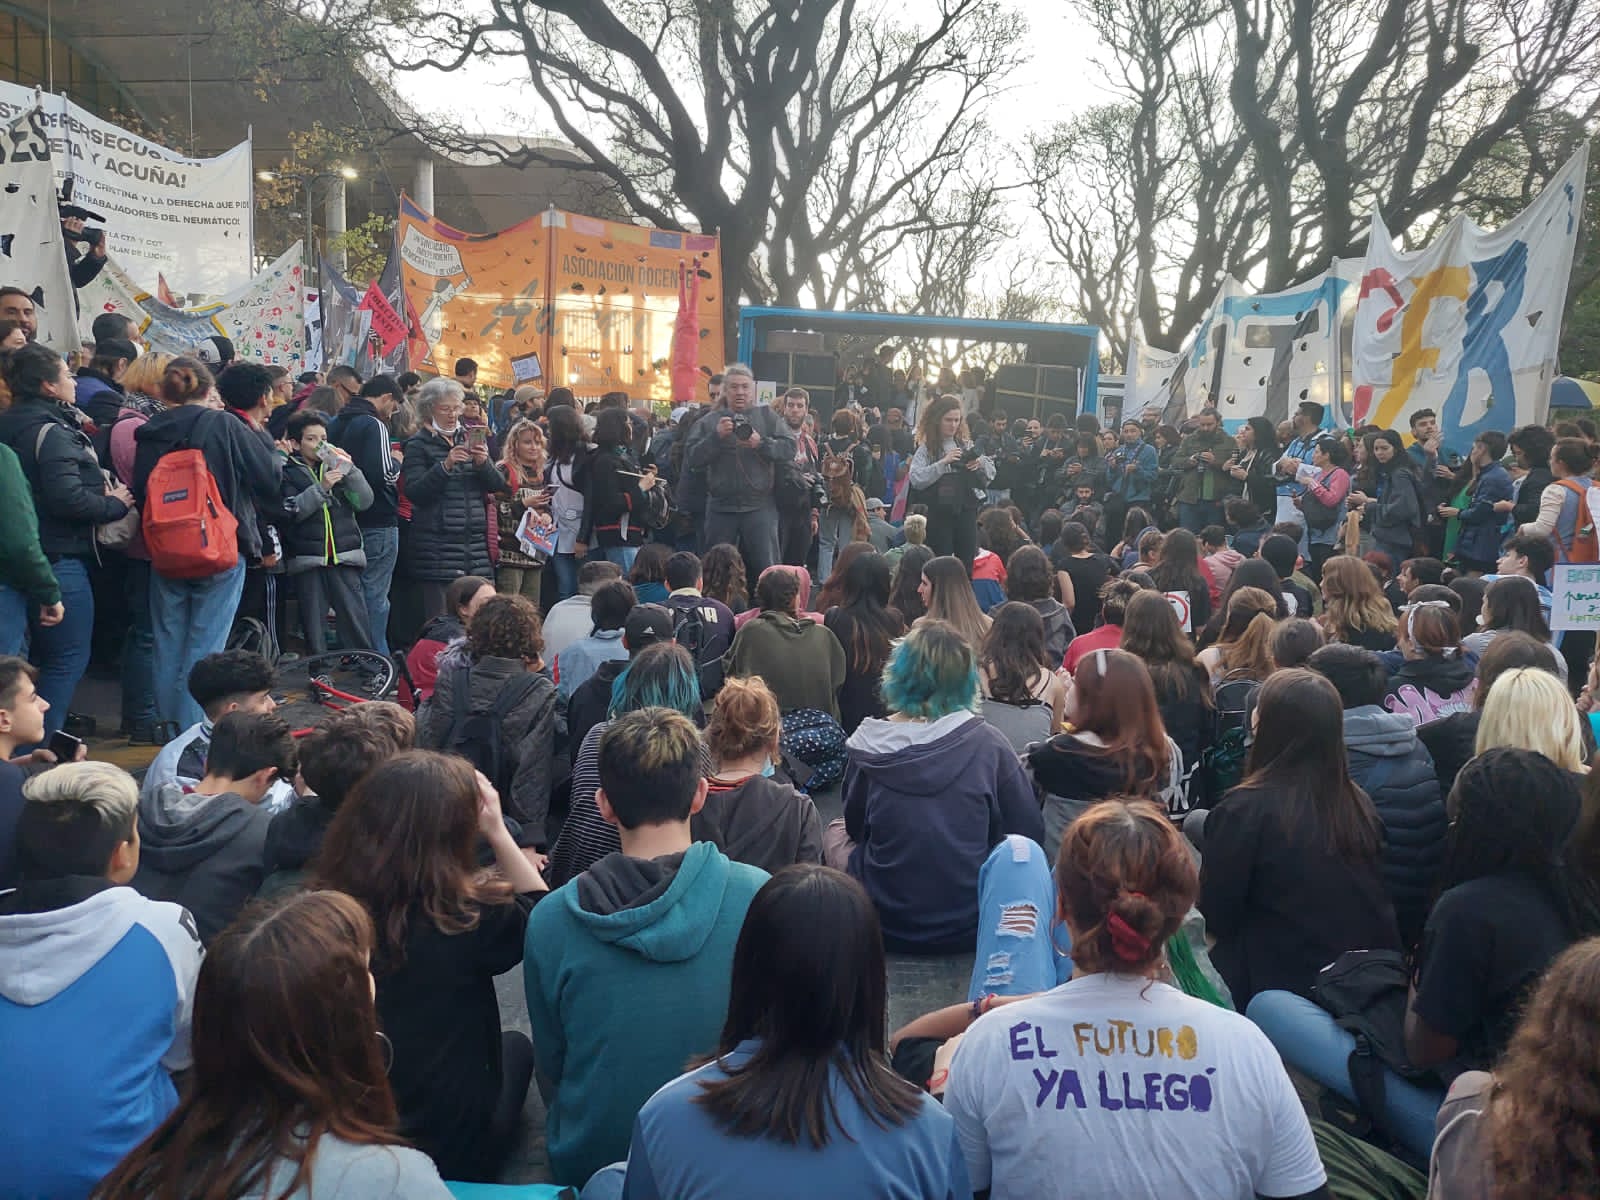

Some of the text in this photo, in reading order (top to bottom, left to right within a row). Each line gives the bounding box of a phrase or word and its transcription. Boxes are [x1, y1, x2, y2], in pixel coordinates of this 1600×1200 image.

[91, 152, 101, 166] Y
[104, 157, 187, 190] ACUÑA!
[150, 196, 165, 206] LA
[166, 198, 214, 209] DERECHA
[215, 201, 233, 210] QUE
[160, 213, 181, 223] DEL
[562, 254, 635, 285] ASOCIACIÓN
[1008, 1019, 1199, 1061] EL FUTURO
[1032, 1067, 1088, 1110] YA
